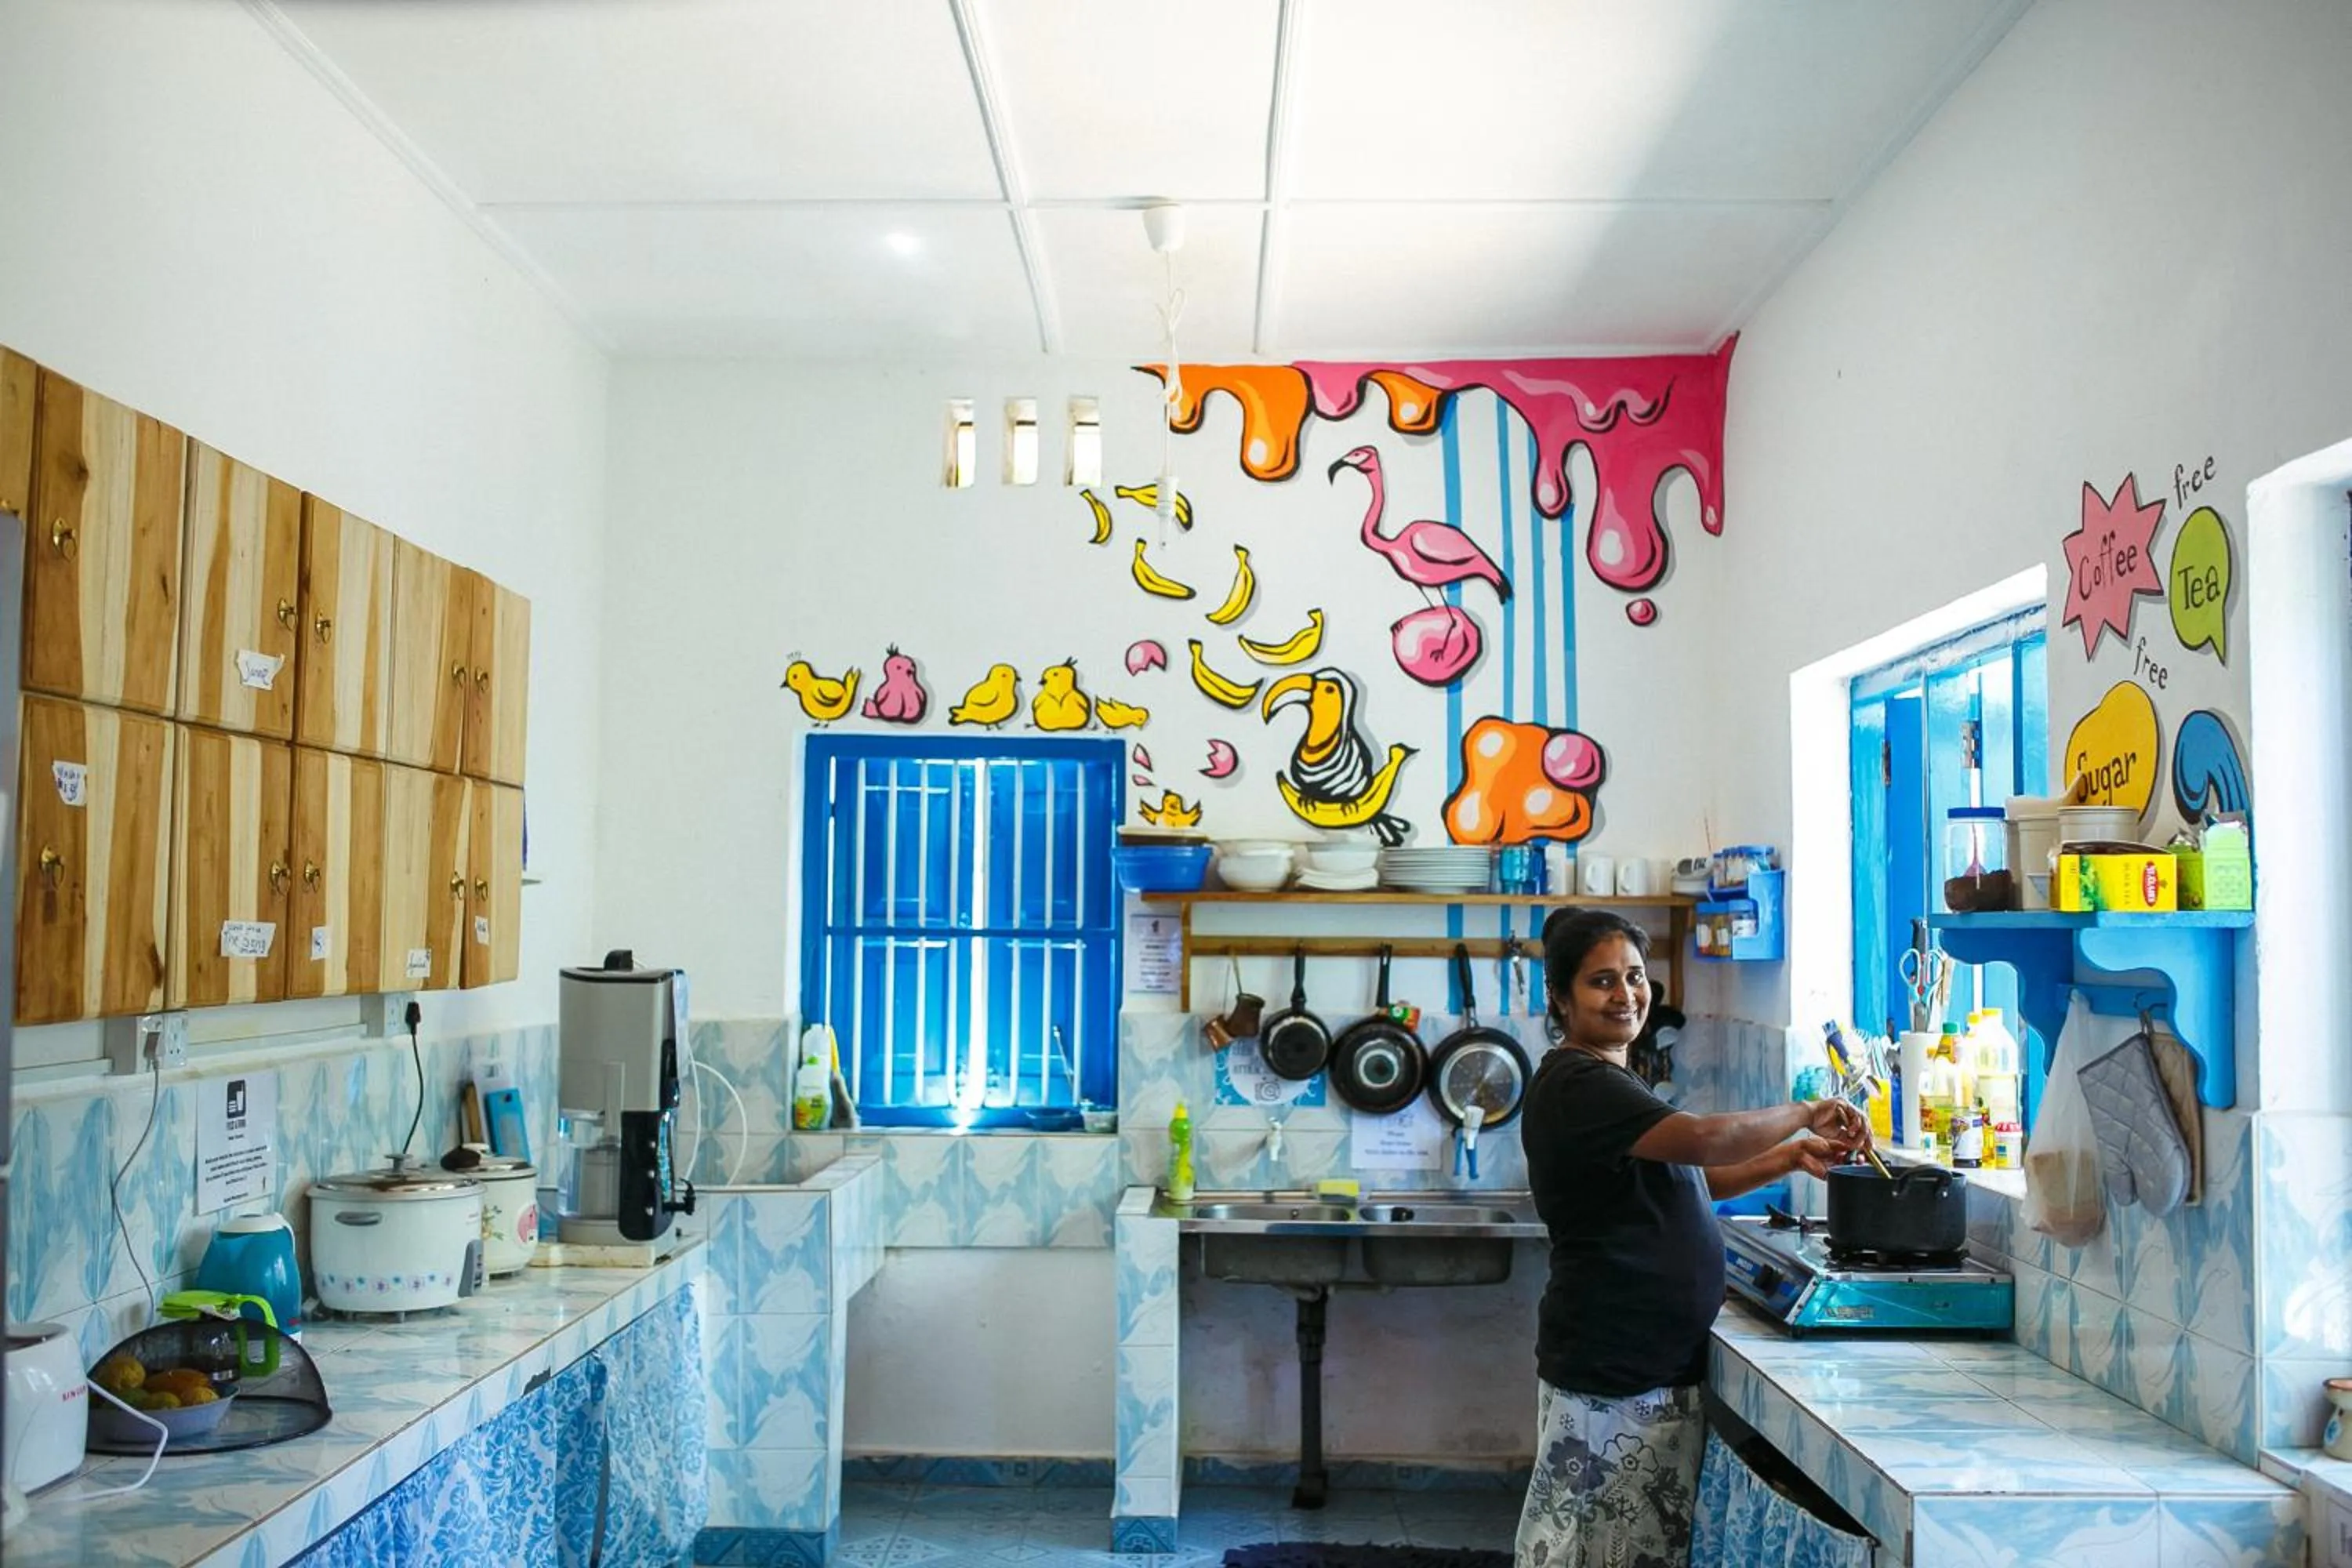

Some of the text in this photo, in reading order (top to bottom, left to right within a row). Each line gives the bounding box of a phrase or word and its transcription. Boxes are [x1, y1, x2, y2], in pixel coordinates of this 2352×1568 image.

[2173, 456, 2216, 510] free
[2078, 529, 2138, 601] Coffee
[2177, 565, 2221, 611] Tea
[2133, 636, 2169, 690] free
[2077, 751, 2137, 807] Sugar
